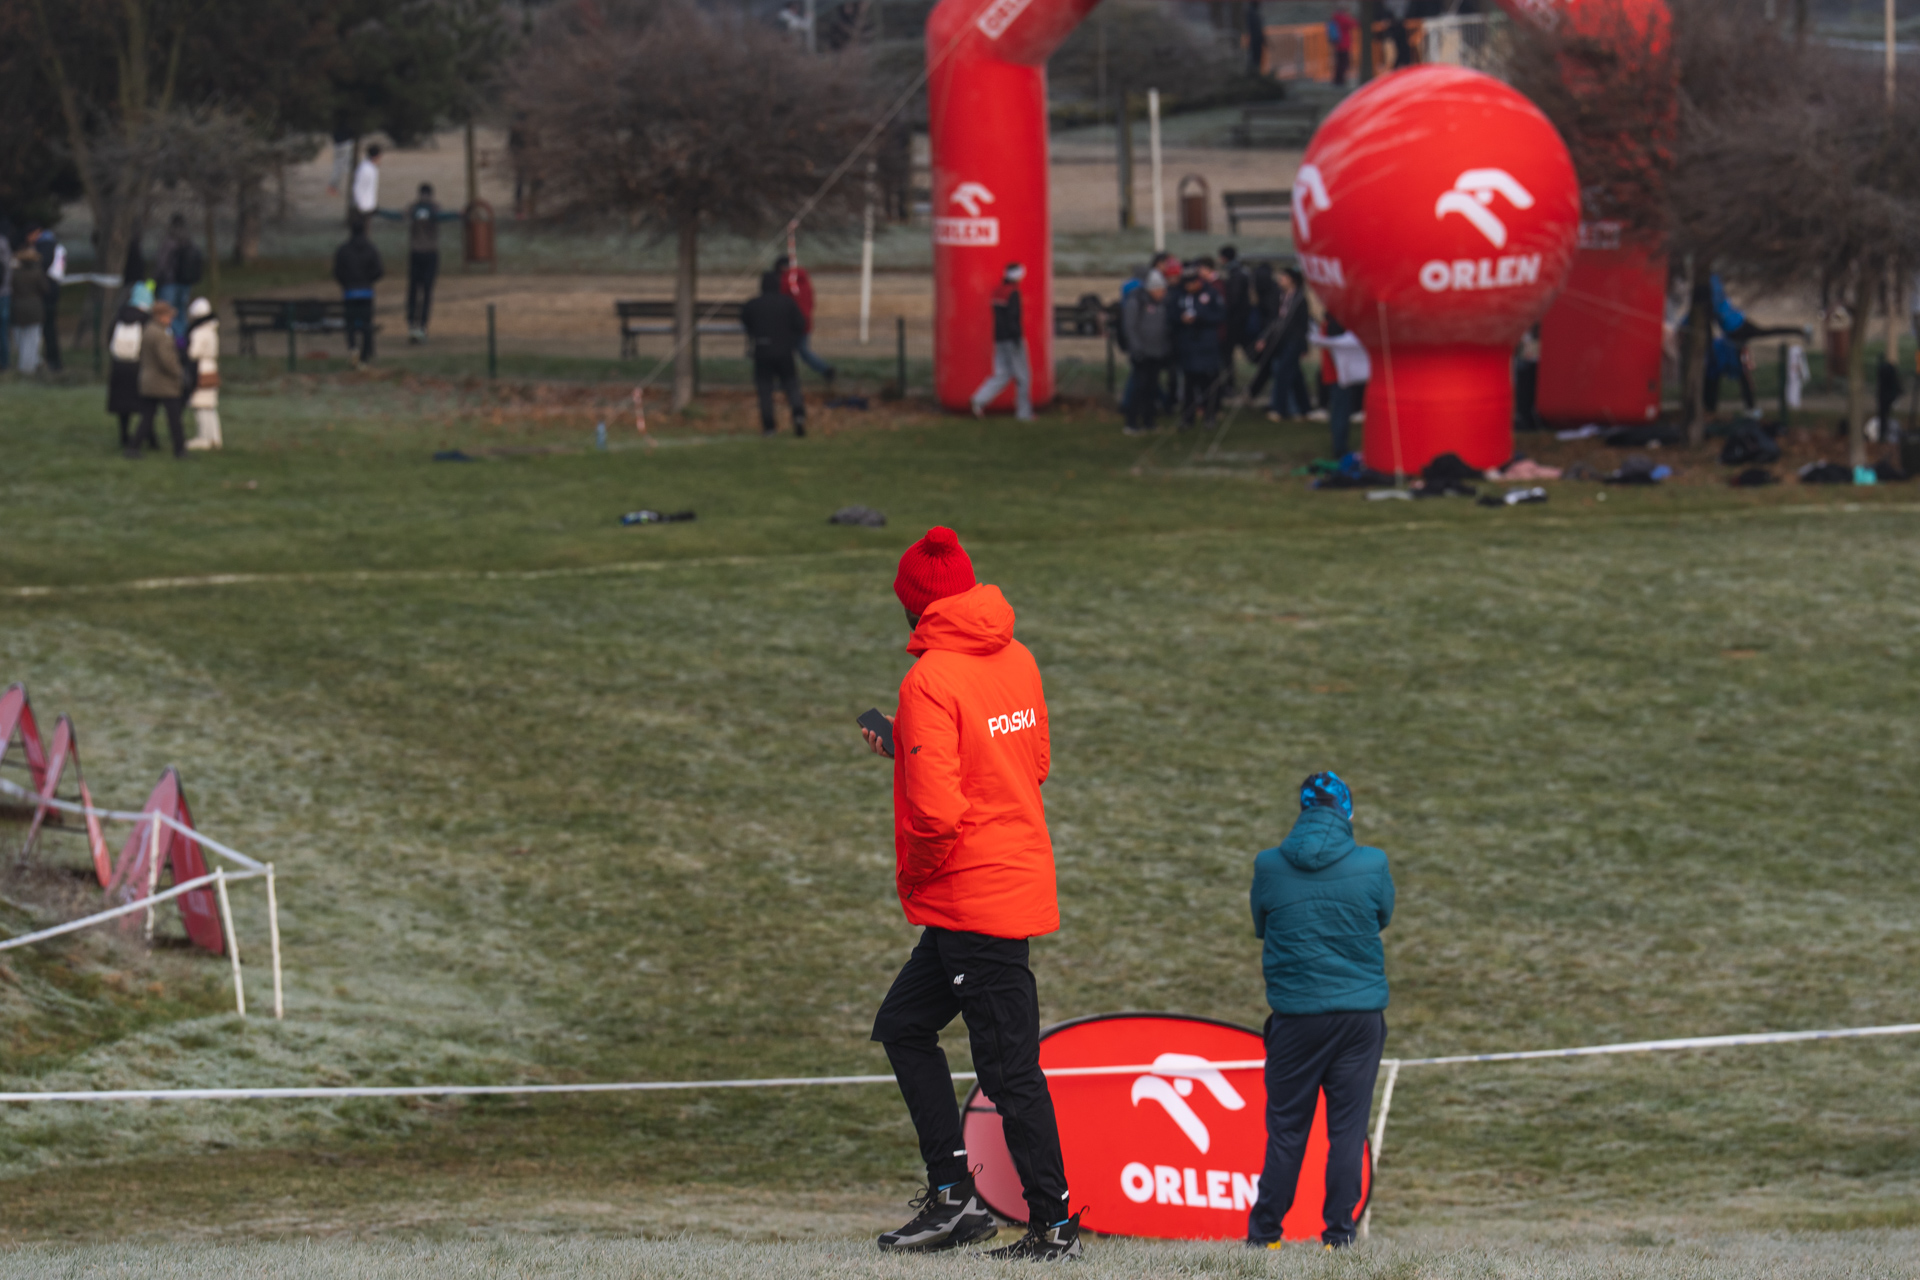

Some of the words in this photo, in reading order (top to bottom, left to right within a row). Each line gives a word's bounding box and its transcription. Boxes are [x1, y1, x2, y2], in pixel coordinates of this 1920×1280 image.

[1419, 253, 1541, 292] ORLEN
[987, 707, 1037, 738] POLSKA
[1120, 1161, 1261, 1211] ORLEN
